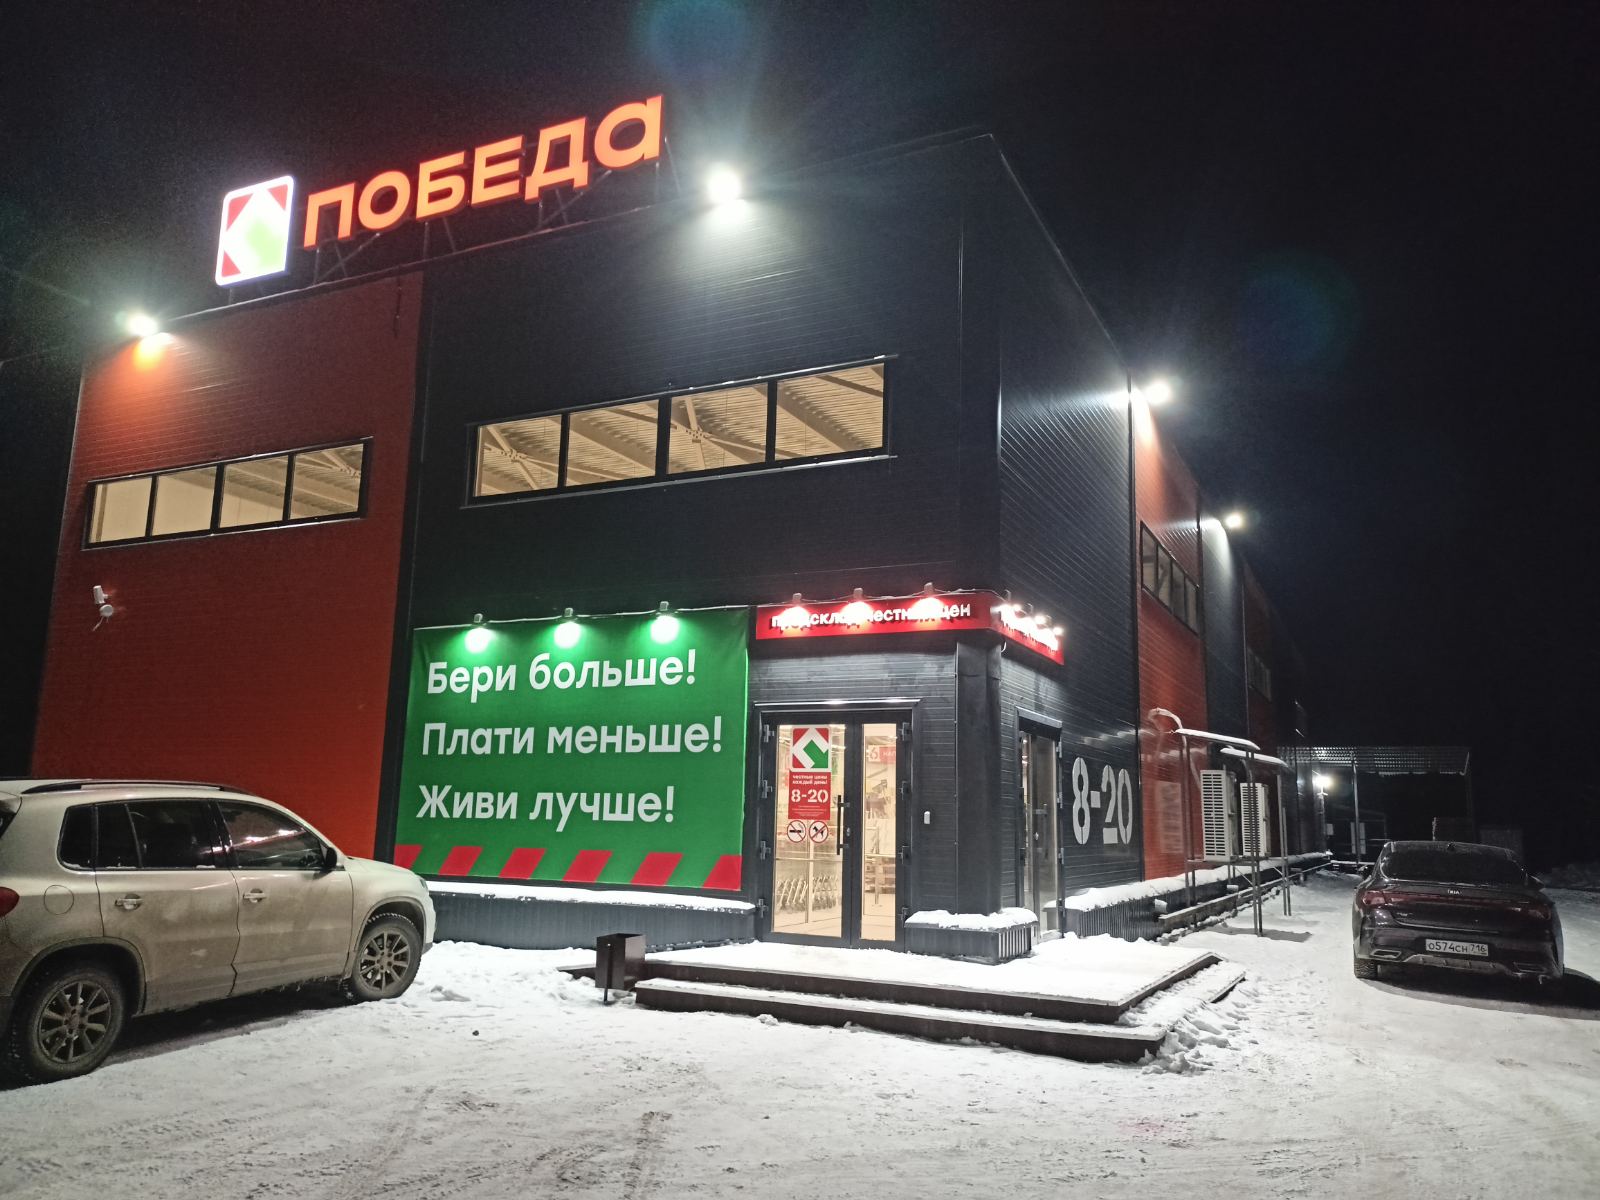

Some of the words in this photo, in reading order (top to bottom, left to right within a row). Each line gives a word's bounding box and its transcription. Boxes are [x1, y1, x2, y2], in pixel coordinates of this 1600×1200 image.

[427, 661, 516, 703] Бери
[529, 648, 696, 690] больше!
[422, 722, 535, 756] Плати
[546, 716, 722, 753] меньше!
[416, 785, 518, 819] Живи
[529, 786, 675, 832] лучше!
[791, 789, 829, 803] 8-20
[1072, 757, 1133, 845] 8-20
